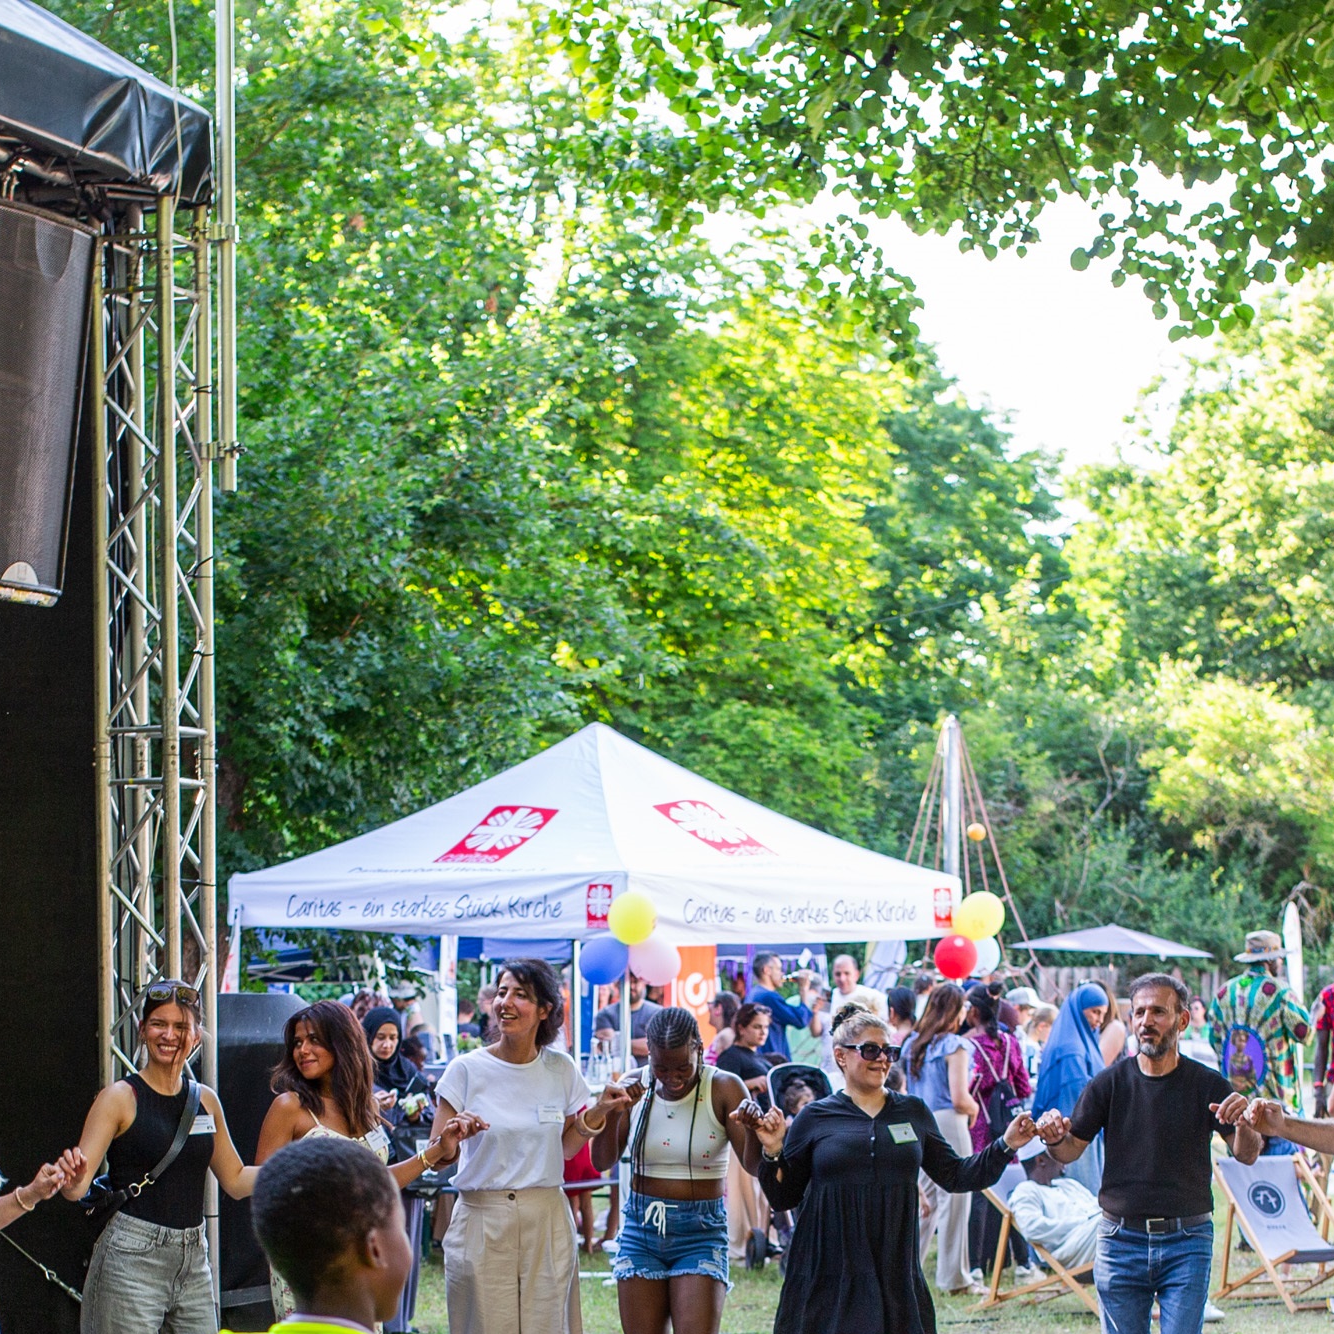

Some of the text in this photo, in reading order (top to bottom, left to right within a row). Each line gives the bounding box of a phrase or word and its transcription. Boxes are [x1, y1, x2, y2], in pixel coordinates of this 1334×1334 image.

[286, 894, 343, 919] Caritas
[362, 899, 385, 918] ein
[390, 895, 448, 919] starkes
[453, 893, 505, 920] Stück
[506, 894, 563, 919] Kirche
[683, 898, 736, 924] Caritas
[754, 904, 777, 923] ein
[780, 900, 830, 924] starkes
[832, 898, 874, 924] Stück
[875, 898, 918, 923] Kirche
